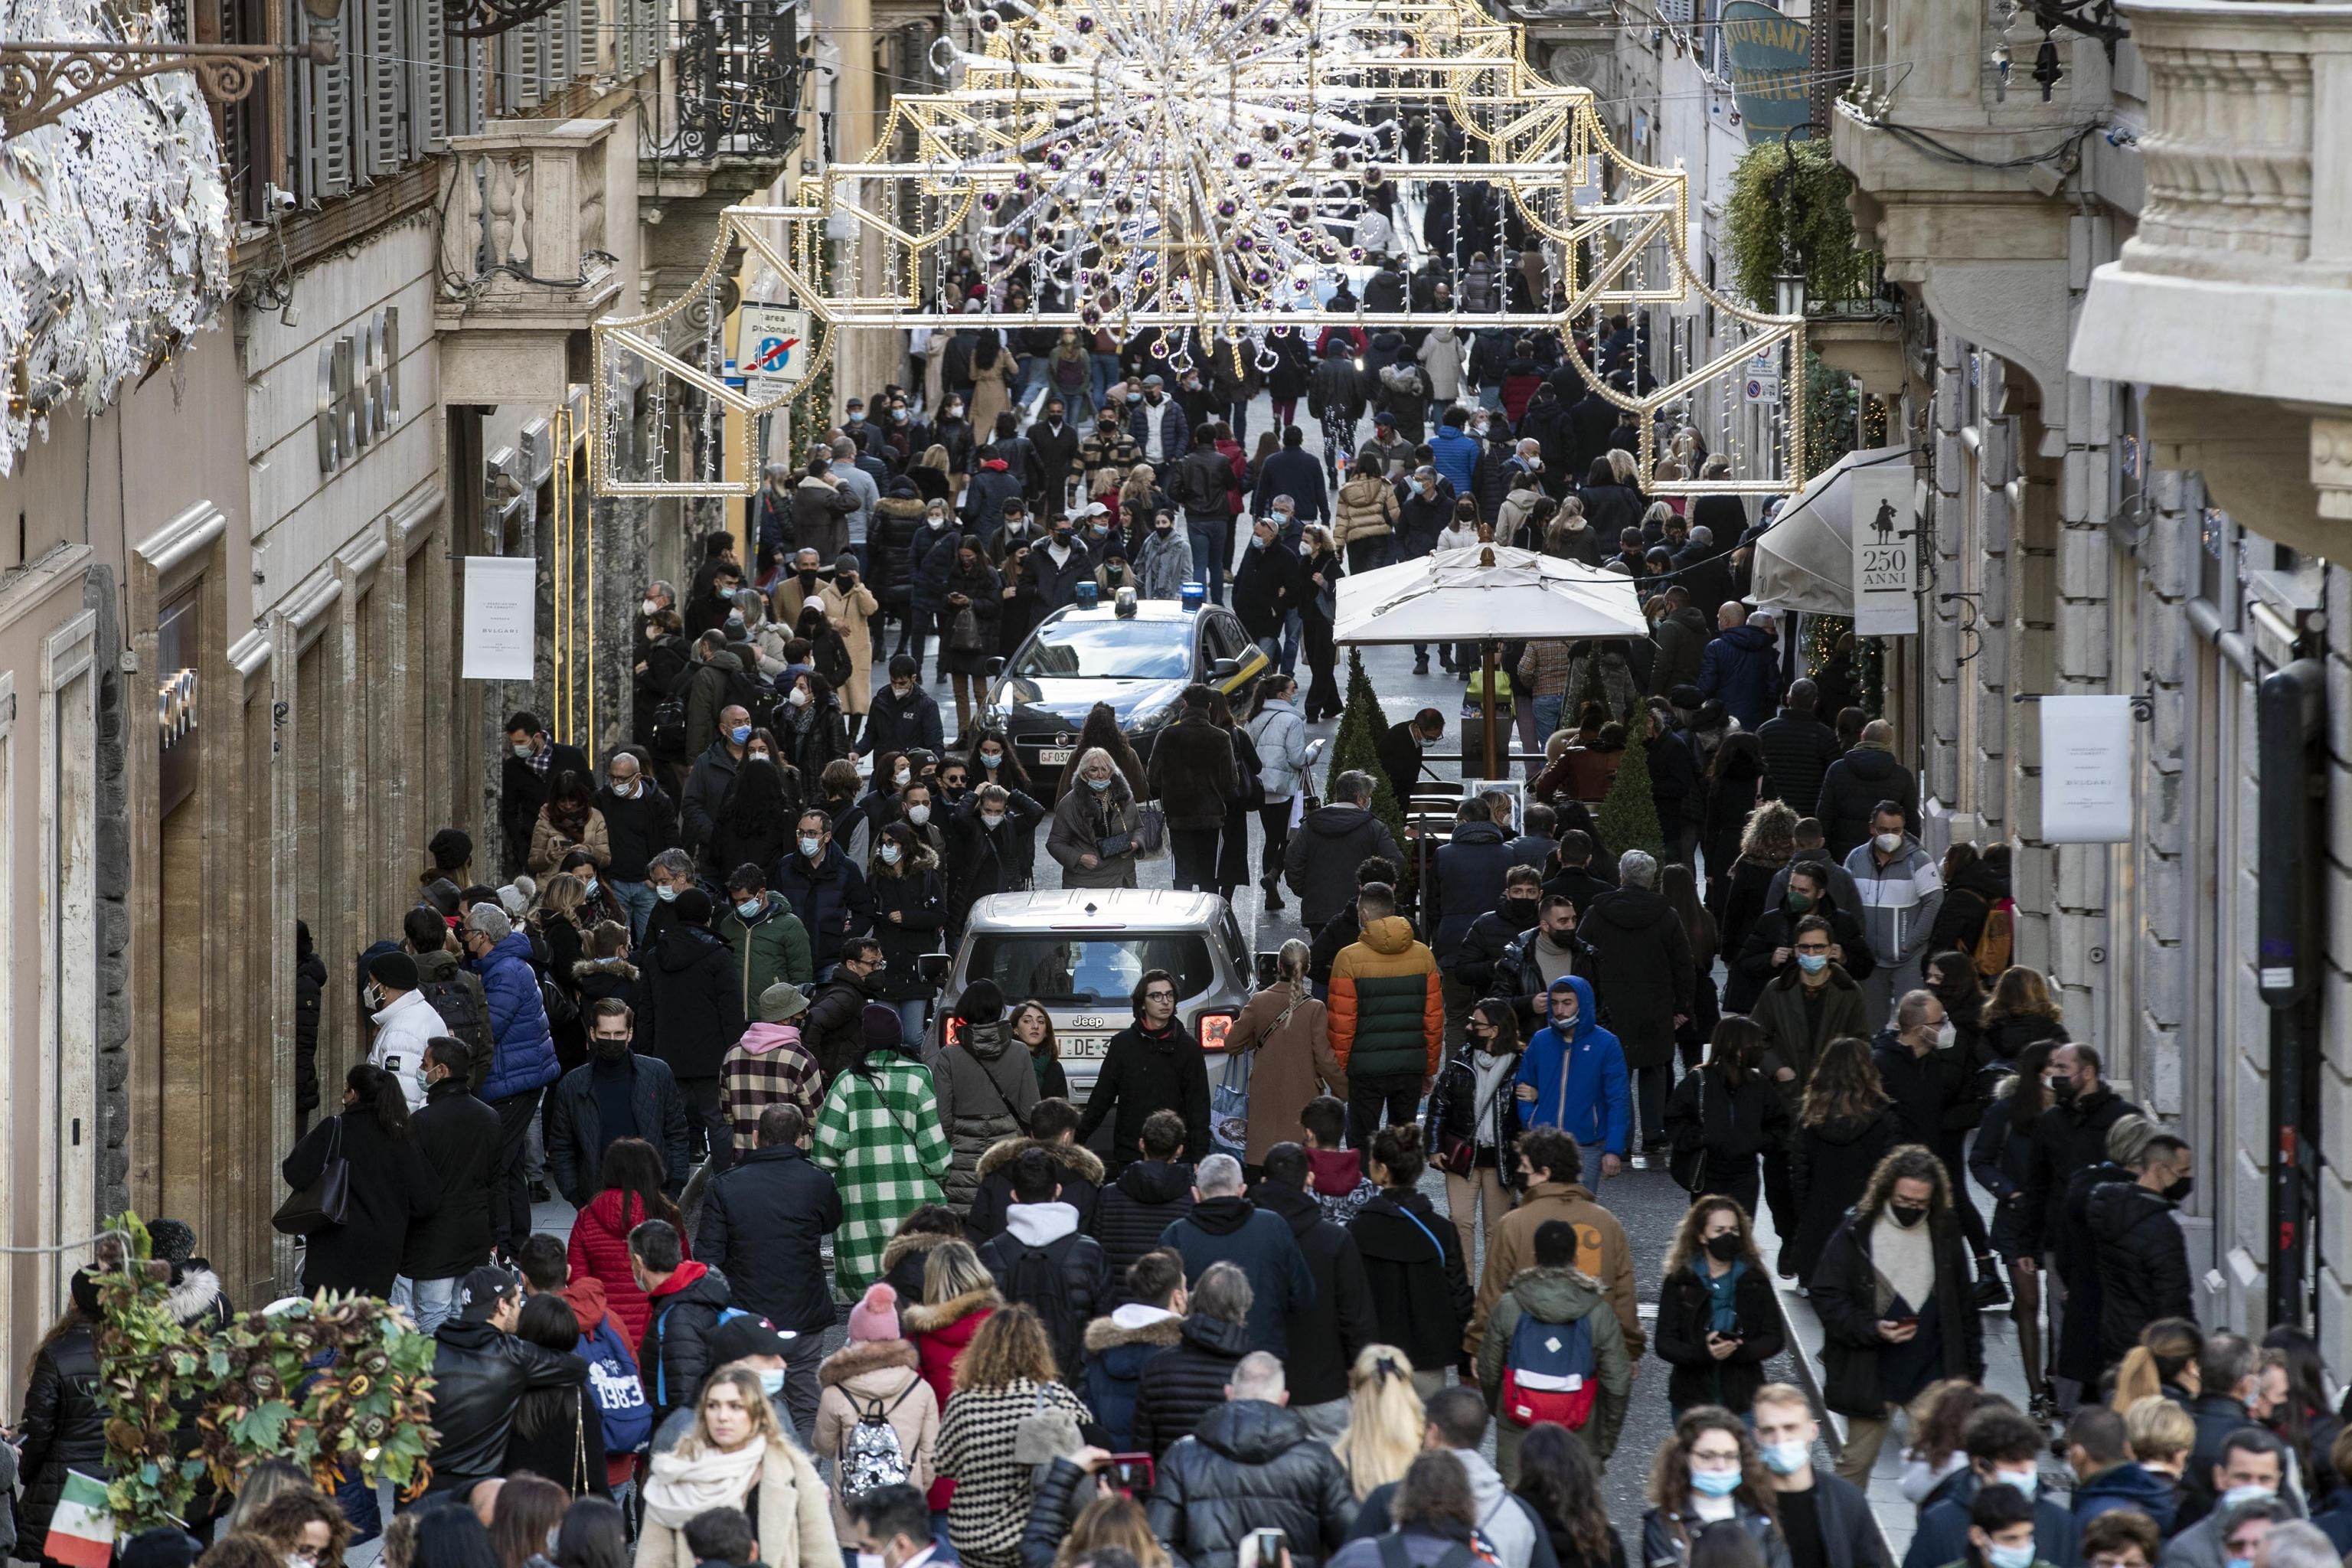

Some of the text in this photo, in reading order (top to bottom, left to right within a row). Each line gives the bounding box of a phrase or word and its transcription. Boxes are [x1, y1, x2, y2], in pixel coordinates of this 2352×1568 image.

[765, 314, 786, 322] area
[1864, 550, 1906, 572] 250
[1864, 573, 1906, 584] ANNI
[1073, 1014, 1103, 1028] Jeep
[597, 1379, 644, 1409] 1983
